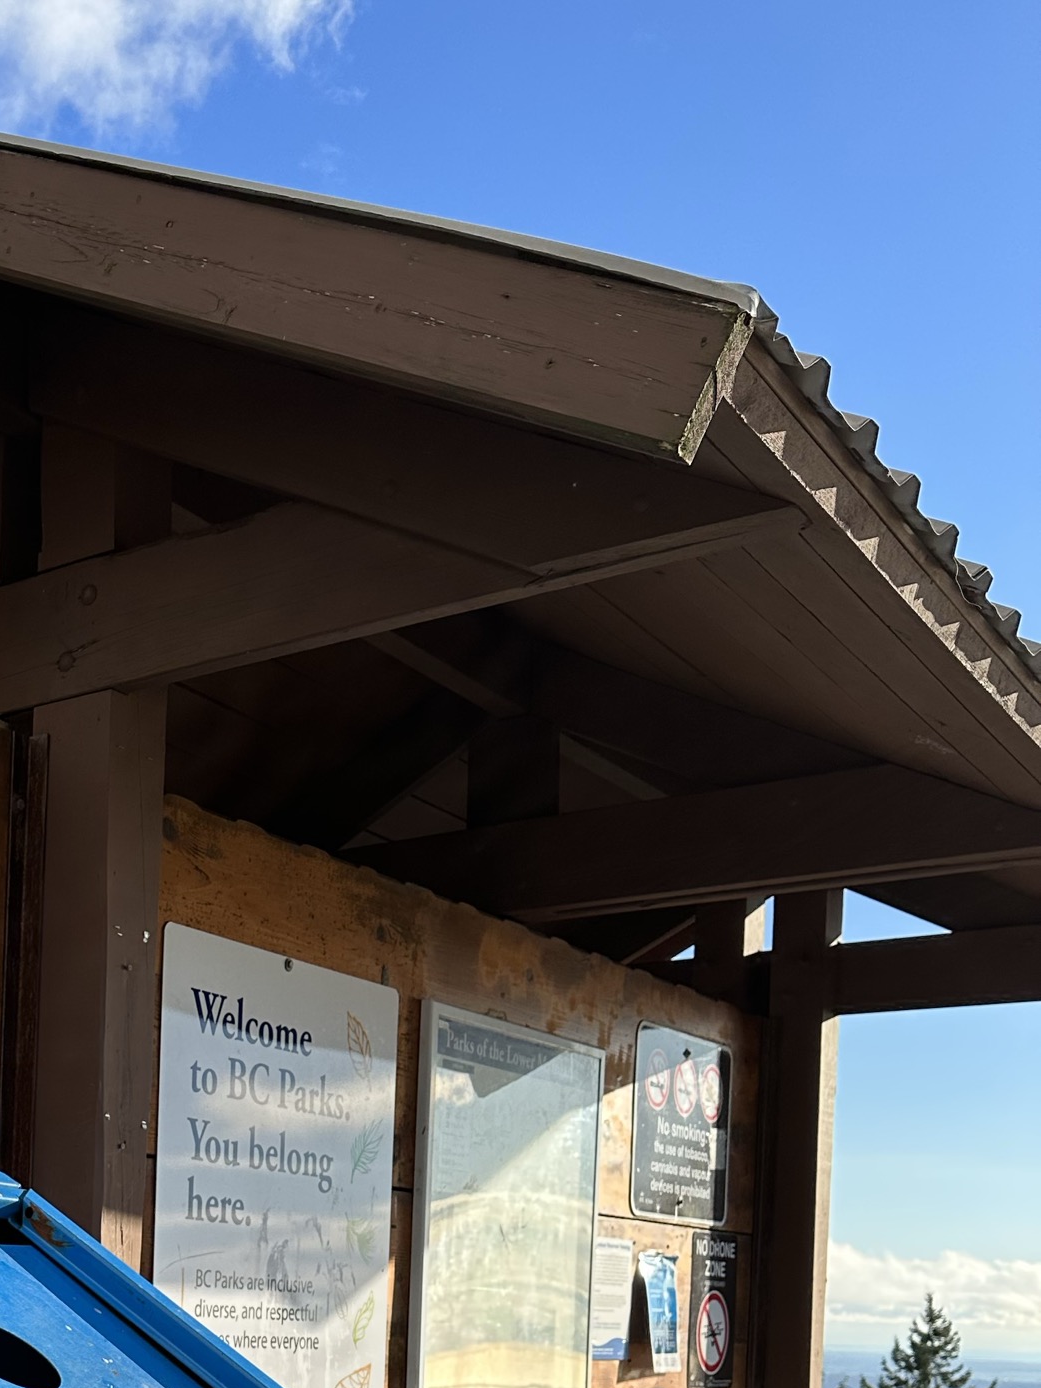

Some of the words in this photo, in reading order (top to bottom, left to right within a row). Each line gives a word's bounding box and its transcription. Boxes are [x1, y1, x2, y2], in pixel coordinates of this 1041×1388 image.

[191, 987, 313, 1057] Welcome
[446, 1029, 475, 1054] Parks
[476, 1039, 488, 1058] of
[489, 1040, 505, 1062] the
[505, 1045, 536, 1070] Lower
[190, 1060, 218, 1095] to
[227, 1057, 270, 1106] BC
[277, 1068, 350, 1122] Parks.
[657, 1115, 670, 1136] No
[187, 1117, 240, 1167] You
[248, 1125, 334, 1194] belong
[654, 1139, 665, 1154] the
[665, 1144, 677, 1157] use
[677, 1145, 684, 1158] of
[650, 1160, 679, 1176] cannabis
[679, 1165, 691, 1178] and
[650, 1178, 674, 1194] devices
[185, 1175, 252, 1227] here.
[696, 1238, 708, 1256] NO
[708, 1239, 736, 1259] DRONE
[704, 1259, 726, 1277] ZONE
[195, 1268, 212, 1288] BC
[214, 1270, 244, 1290] Parks
[246, 1276, 265, 1291] are
[266, 1273, 315, 1296] inclusive,
[194, 1298, 239, 1322] diverse,
[241, 1301, 263, 1320] and
[265, 1303, 318, 1326] respectful
[233, 1330, 269, 1350] where
[270, 1335, 319, 1354] everyone
